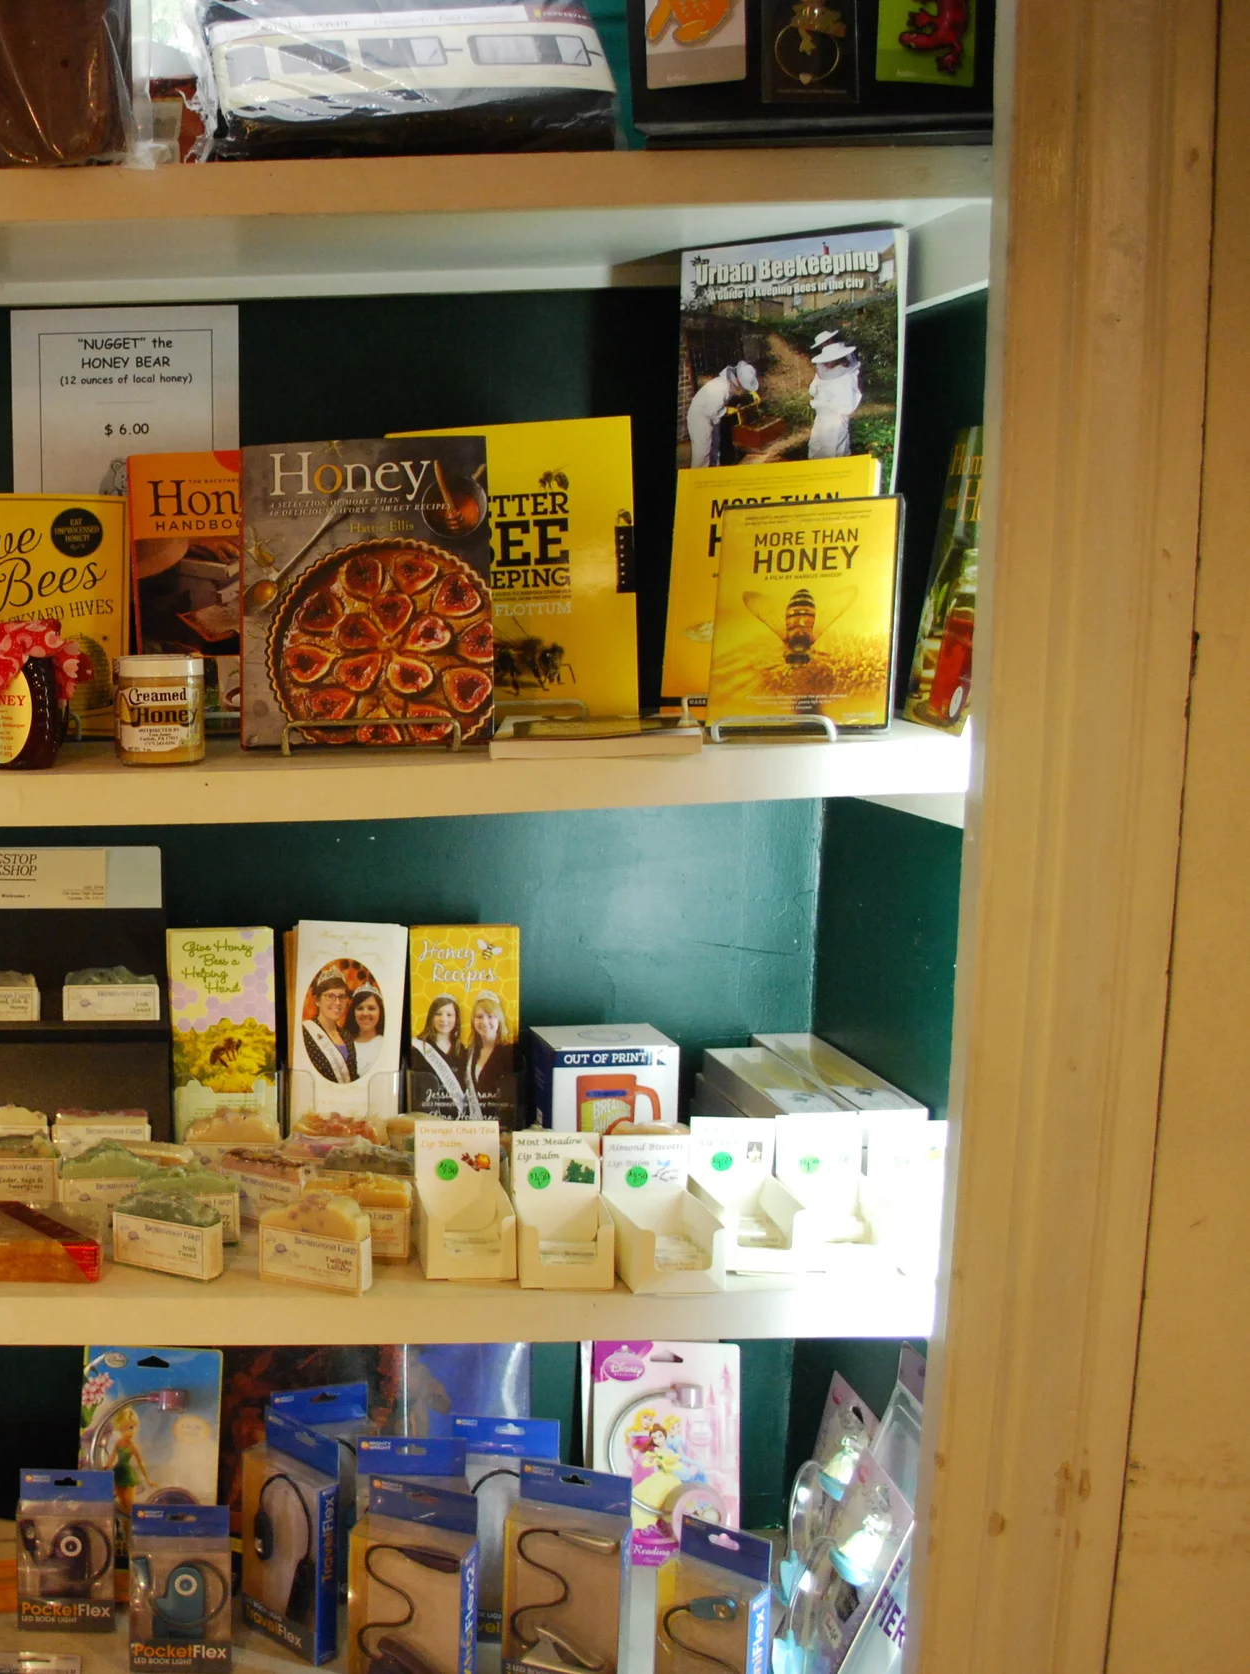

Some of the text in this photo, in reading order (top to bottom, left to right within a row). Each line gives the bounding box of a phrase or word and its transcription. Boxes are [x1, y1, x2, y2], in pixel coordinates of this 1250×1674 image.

[695, 250, 880, 287] Urban Beekeeping
[717, 277, 865, 300] Guide Keeping Bees City
[151, 337, 173, 349] the
[81, 356, 170, 370] HONEY BEAR
[59, 373, 193, 387] (12 ounces of local honey)
[103, 423, 150, 437] $ 6.00
[269, 451, 431, 501] Honey
[278, 496, 400, 509] SELECTION MORE THAN
[282, 502, 452, 517] DELICIOUS SAVORY SWEET RECIPES
[350, 520, 415, 533] Hattie Ellis
[754, 528, 860, 548] MORE THAN
[753, 545, 861, 574] HONEY
[68, 599, 114, 618] HIVES
[494, 602, 571, 617] FLOTTUM
[128, 687, 188, 705] Creamed
[130, 707, 198, 727] Honey
[182, 939, 255, 958] Give Honey
[419, 938, 478, 967] Honey
[198, 953, 241, 966] Bees a
[181, 965, 229, 985] Helping
[432, 962, 499, 992] Recipes
[204, 981, 241, 995] Hand
[563, 1051, 648, 1065] OUT OF PRINT
[420, 1127, 453, 1136] Orange
[479, 1126, 496, 1134] Tea
[420, 1140, 436, 1148] Lip
[514, 1137, 583, 1147] Mint Meadow
[609, 1143, 647, 1152] Almond
[516, 1151, 561, 1162] Lip Balm
[609, 1363, 643, 1378] Disney
[21, 1601, 111, 1618] PocketFlex
[133, 1643, 228, 1659] PocketFlex
